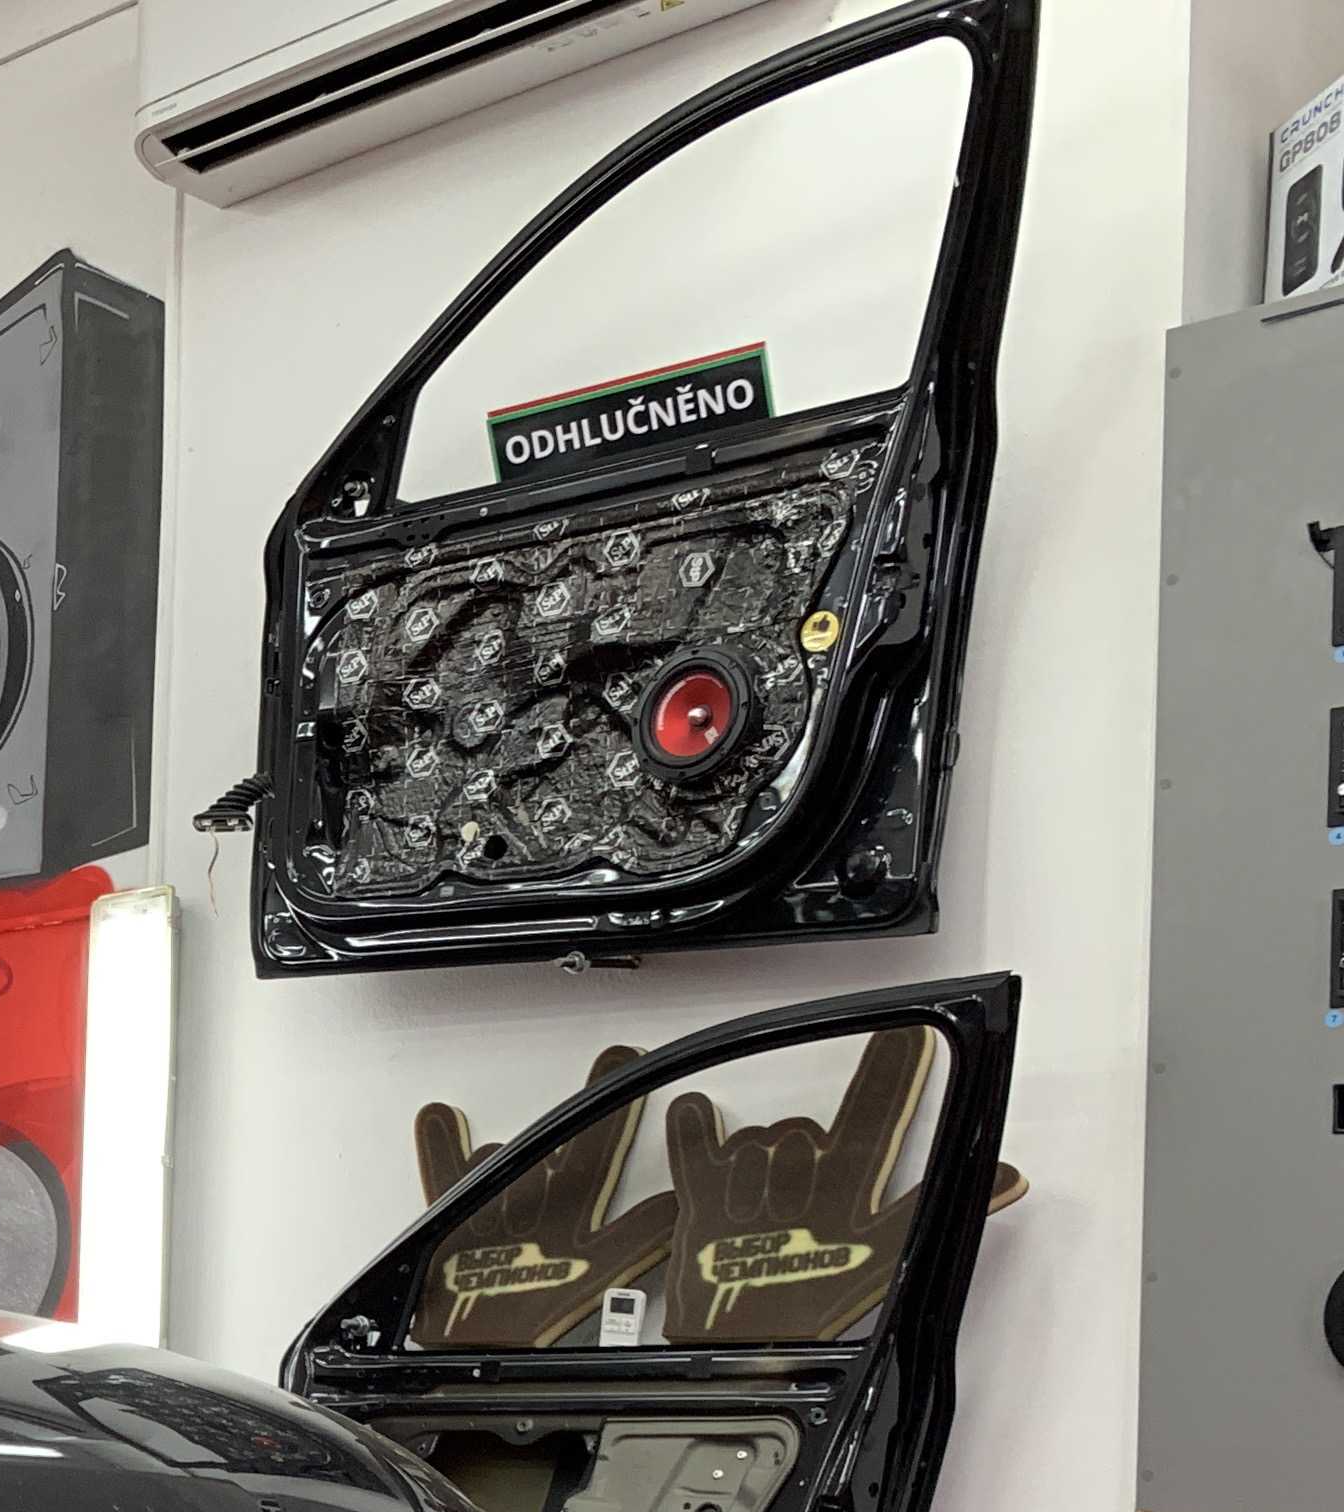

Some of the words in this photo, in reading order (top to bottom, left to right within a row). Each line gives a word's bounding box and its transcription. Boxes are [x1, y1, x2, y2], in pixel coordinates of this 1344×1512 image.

[505, 378, 755, 465] ODHLUČNĚNO
[714, 1232, 792, 1261] ВЫБОР
[455, 1261, 572, 1291] ЧЕМПИОНОВ
[712, 1247, 852, 1282] ЧЕМПИОНОВ
